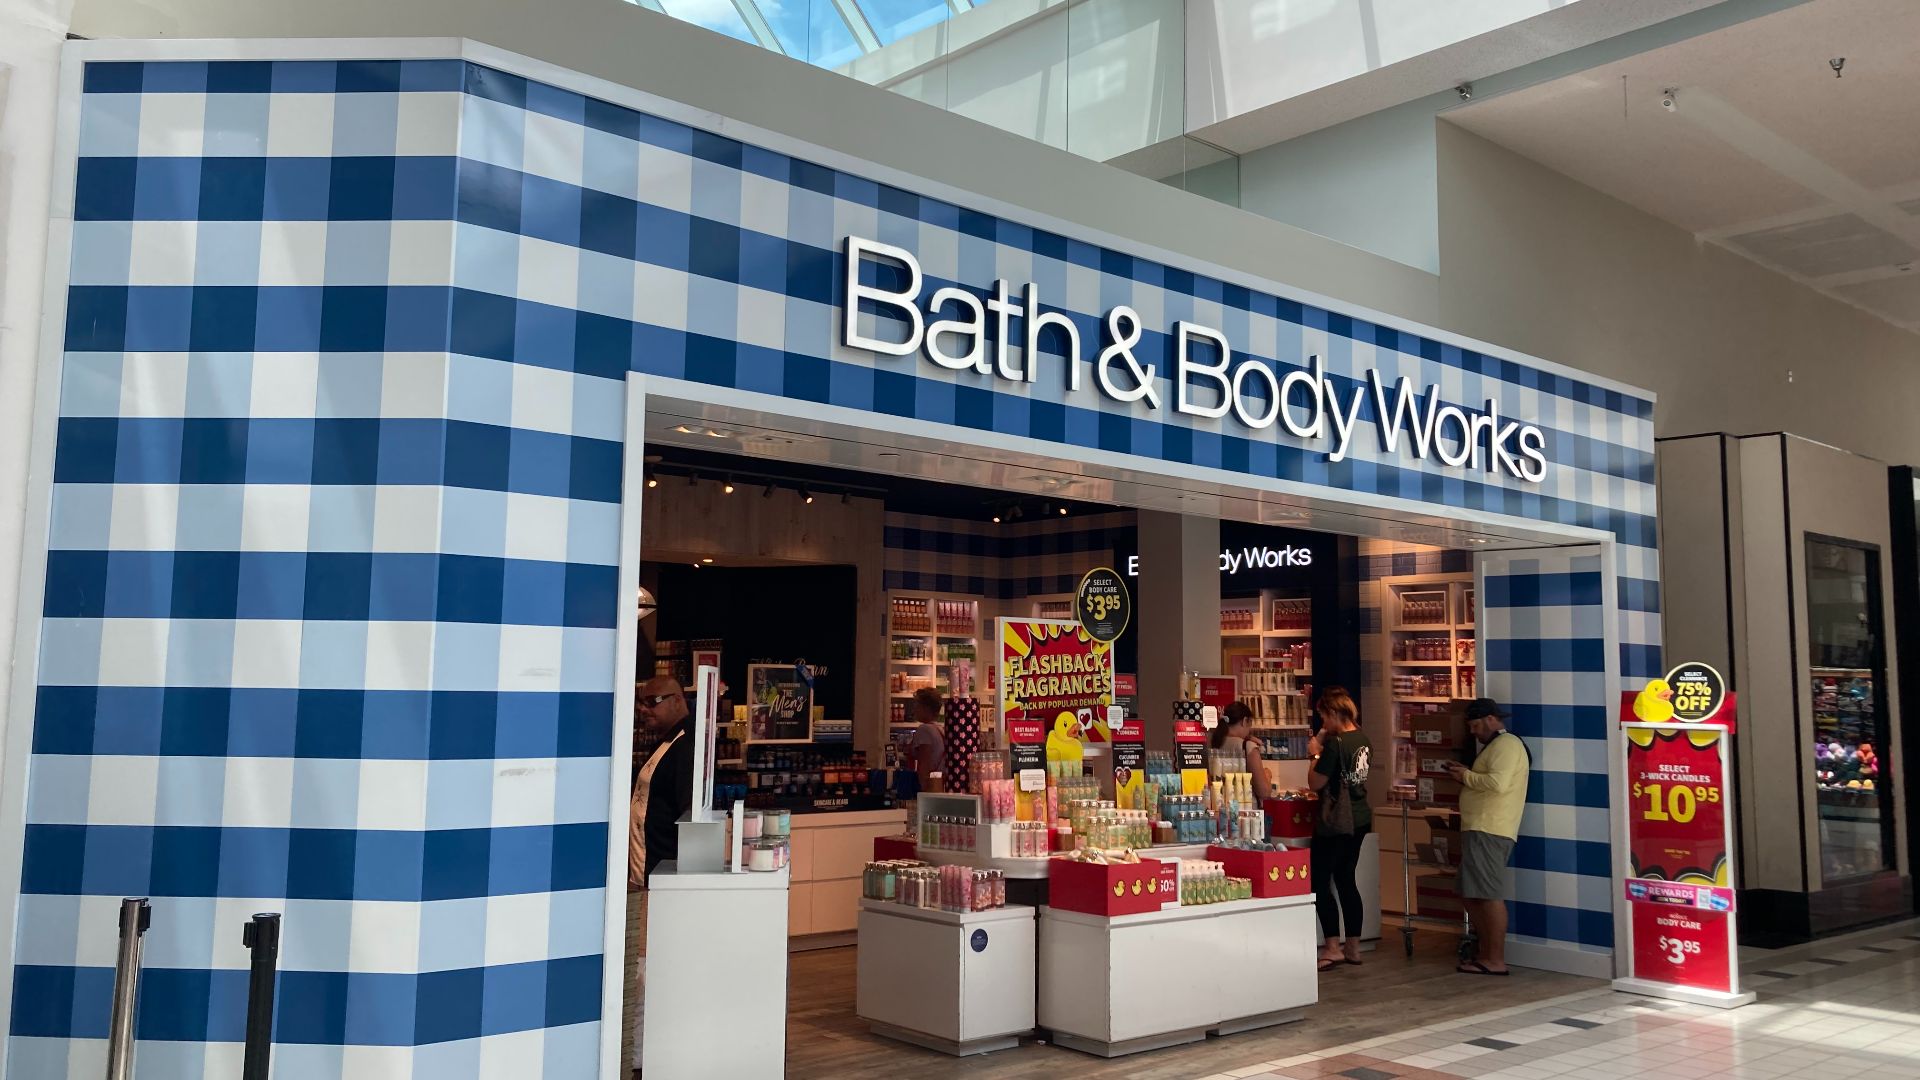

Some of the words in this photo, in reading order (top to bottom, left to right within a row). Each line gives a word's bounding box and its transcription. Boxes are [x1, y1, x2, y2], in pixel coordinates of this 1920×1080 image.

[842, 235, 1081, 391] Bath
[1094, 305, 1160, 410] &
[1173, 320, 1365, 462] Body
[1367, 368, 1546, 482] Works
[1219, 549, 1242, 575] dy
[1243, 544, 1312, 568] Works
[1008, 652, 1105, 677] FLASHBACK
[783, 689, 793, 697] THE
[1004, 674, 1111, 700] FRAGRANCES
[1676, 682, 1712, 696] 75%
[768, 694, 808, 718] Men's
[1019, 702, 1038, 711] BACK
[1038, 700, 1047, 710] BY
[1047, 698, 1078, 709] POPULAR
[1675, 695, 1711, 711] OFF
[1658, 764, 1690, 773] SELECT
[1640, 772, 1670, 780] 3-WICK
[1670, 773, 1711, 783] CANDLES
[1648, 886, 1695, 899] REWARDS
[1656, 917, 1680, 927] BODY
[1680, 920, 1702, 931] CARE
